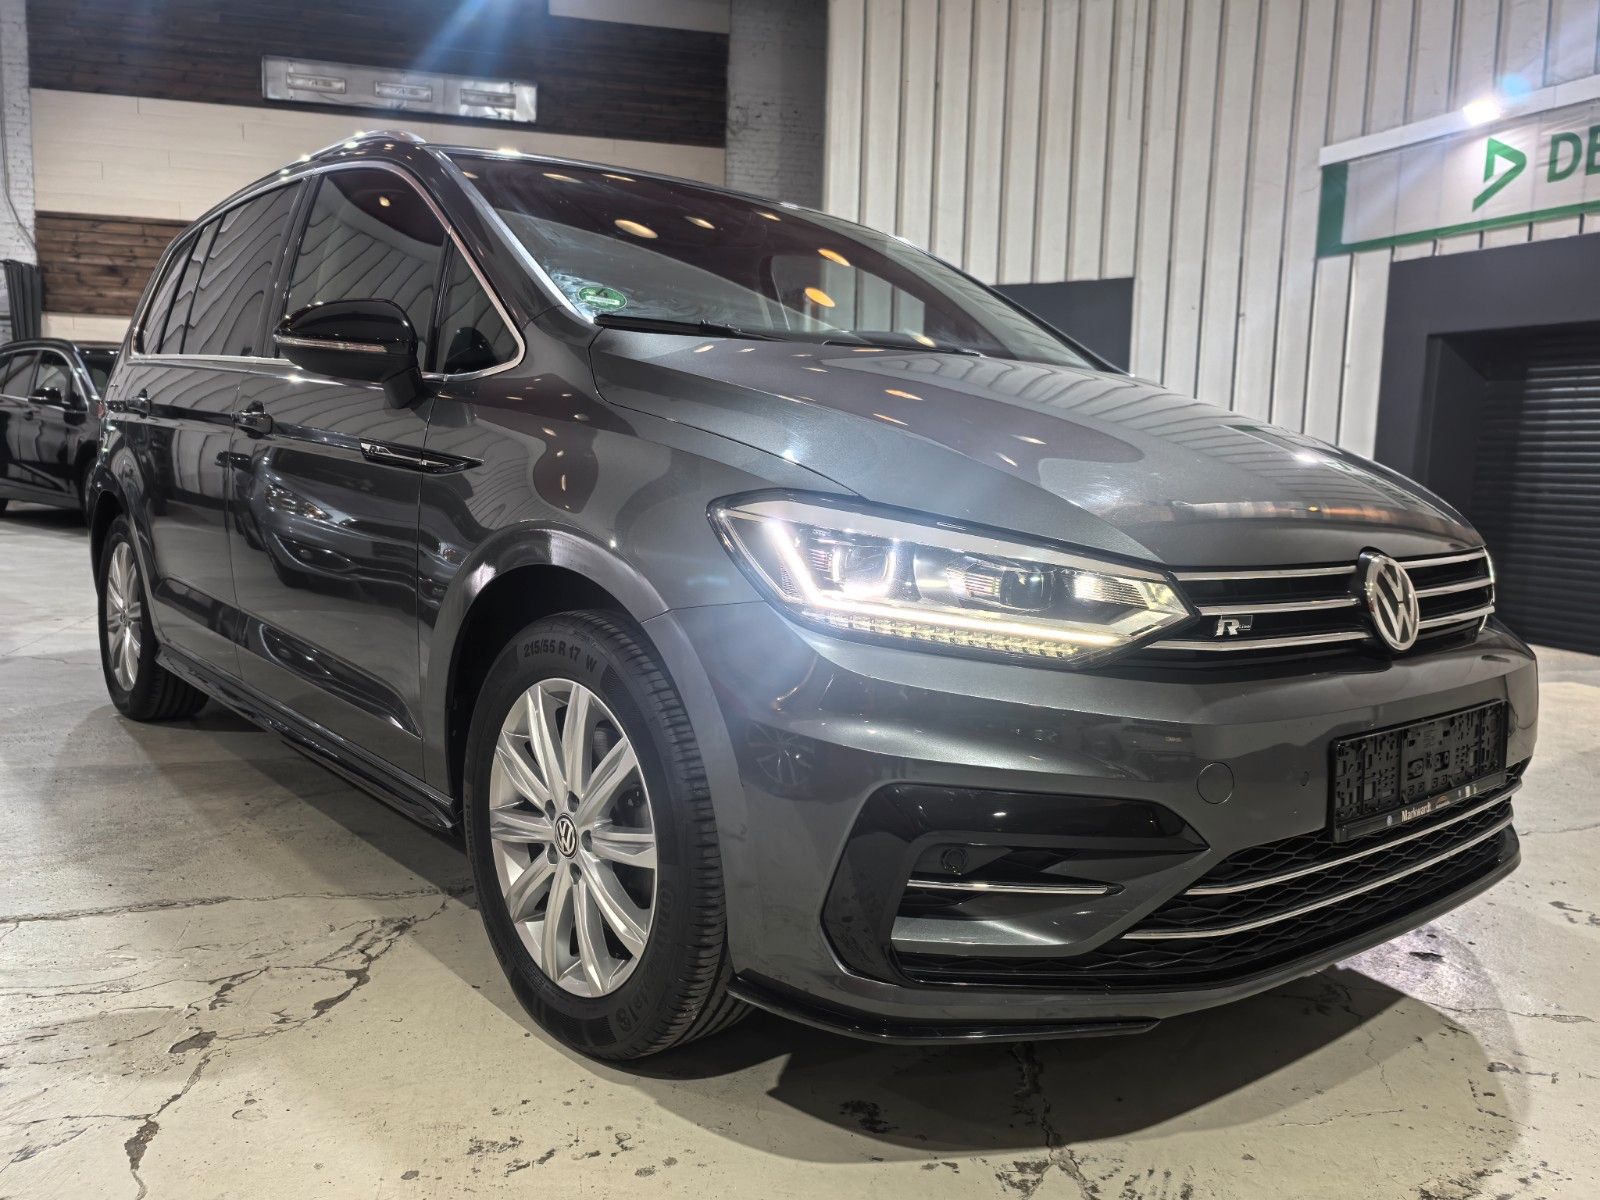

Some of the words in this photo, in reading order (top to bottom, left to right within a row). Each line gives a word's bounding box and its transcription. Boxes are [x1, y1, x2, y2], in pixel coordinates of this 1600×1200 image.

[523, 639, 556, 657] 215/55
[558, 640, 567, 656] R
[569, 644, 582, 662] 17
[585, 654, 598, 673] W
